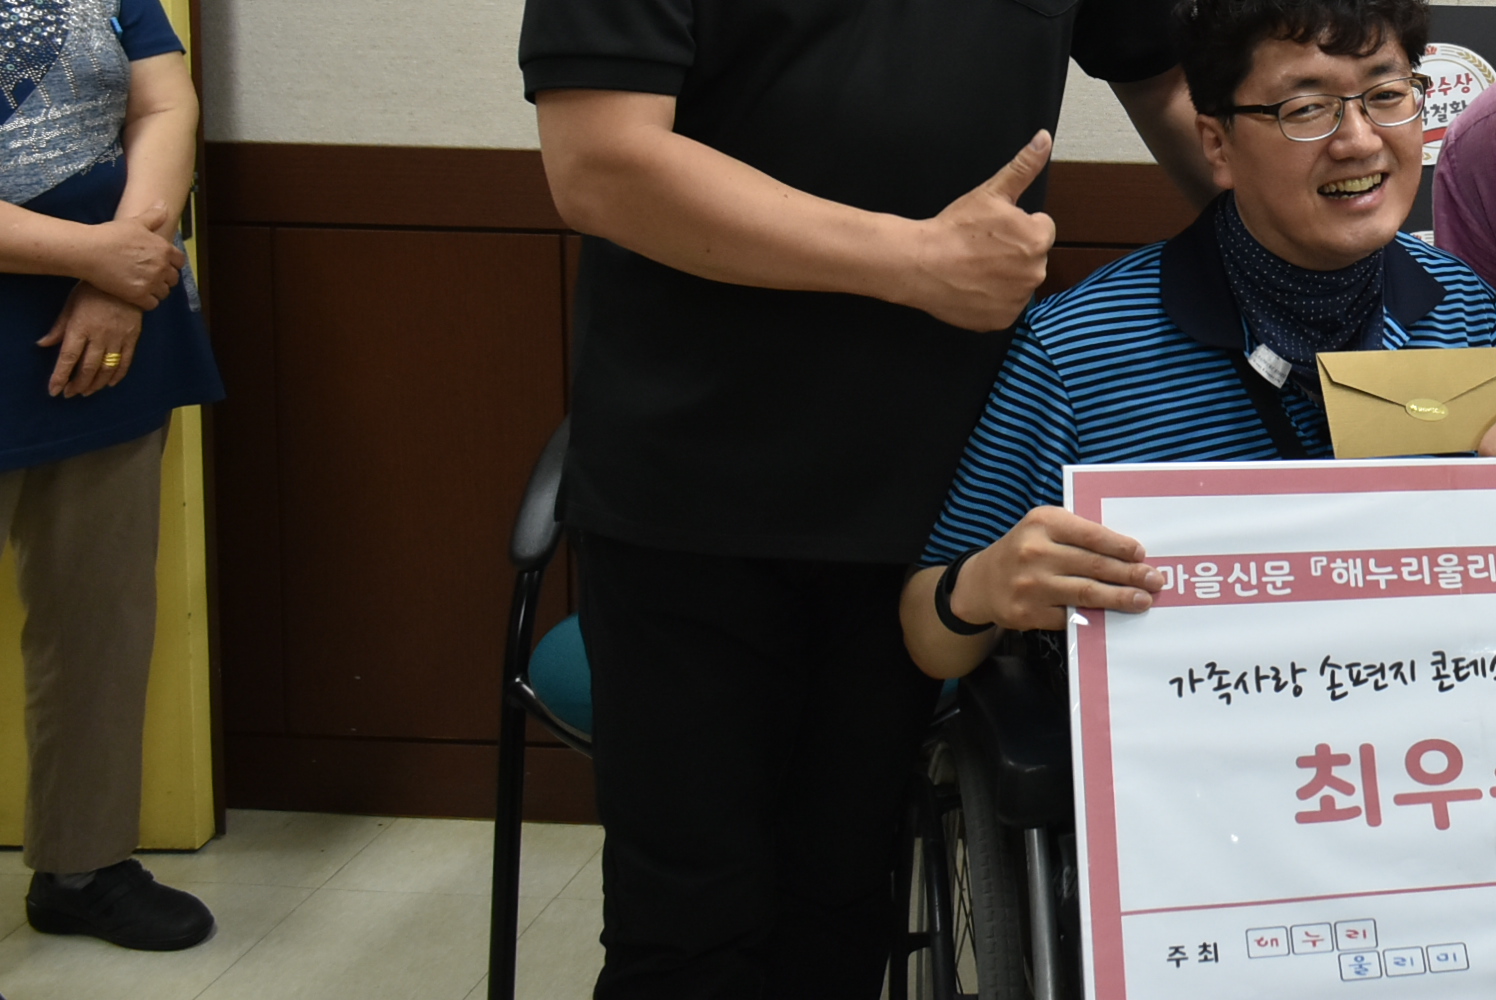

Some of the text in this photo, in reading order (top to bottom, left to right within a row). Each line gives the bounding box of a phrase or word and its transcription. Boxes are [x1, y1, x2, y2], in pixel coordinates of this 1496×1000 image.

[1161, 559, 1295, 599] 마을신문
[1168, 661, 1307, 705] 가족사랑
[1319, 655, 1416, 701] 손편지
